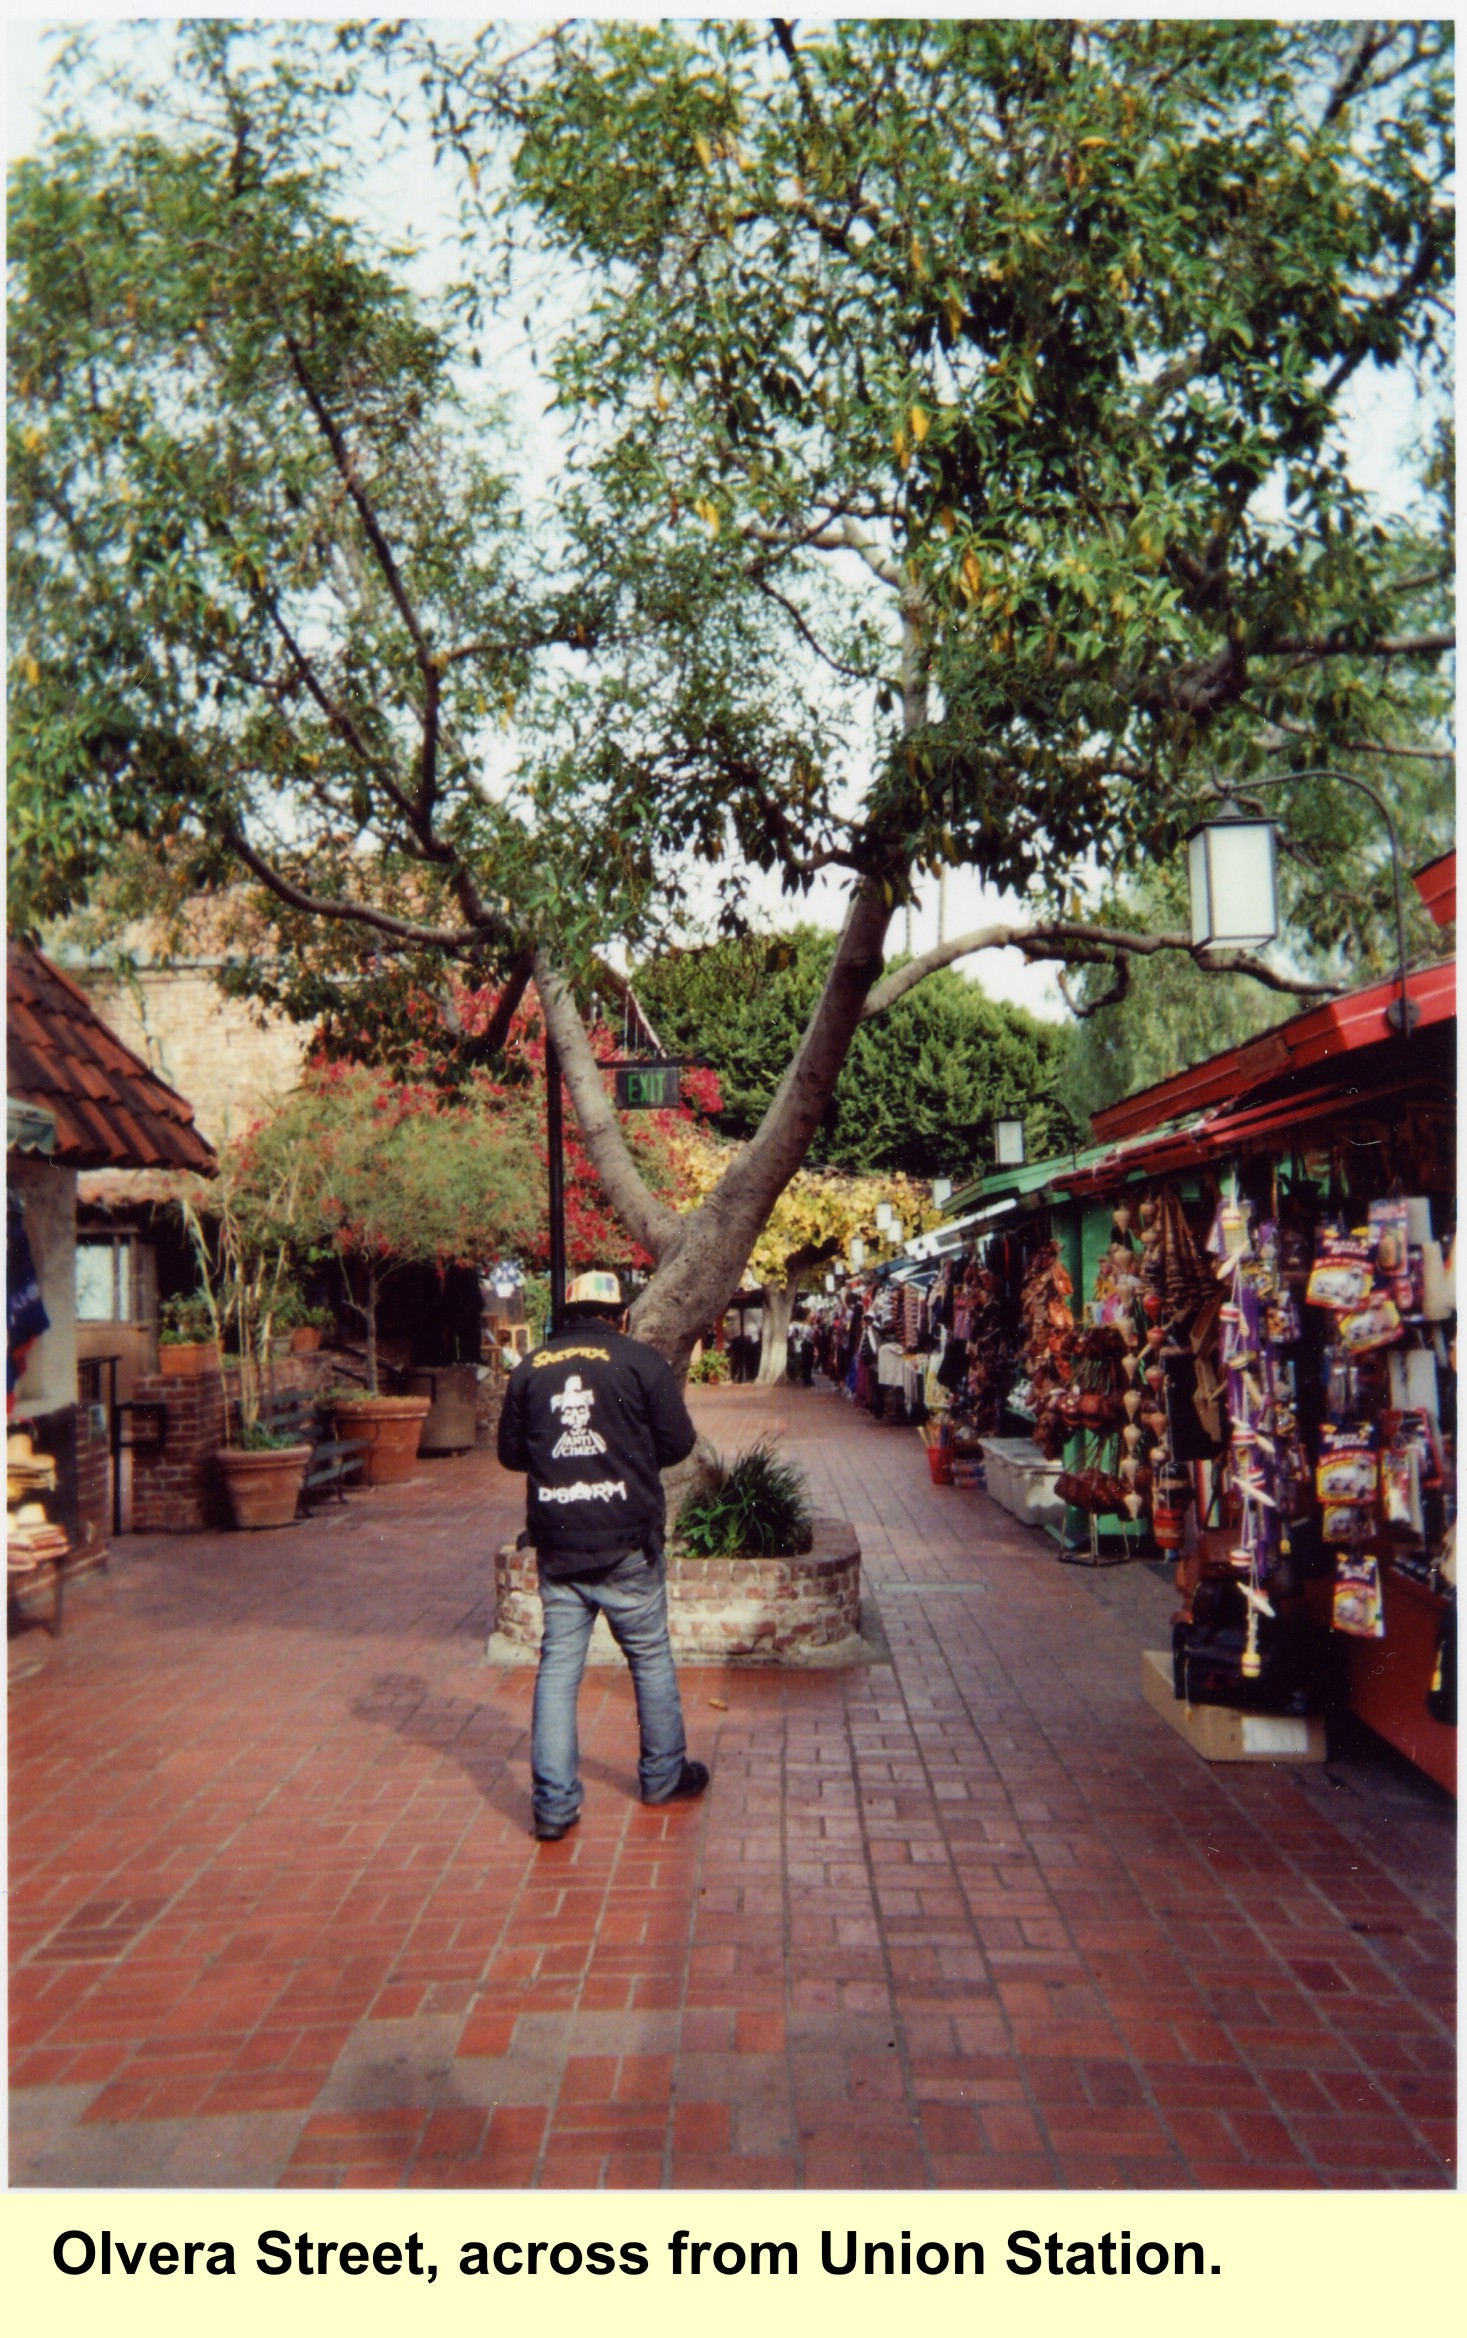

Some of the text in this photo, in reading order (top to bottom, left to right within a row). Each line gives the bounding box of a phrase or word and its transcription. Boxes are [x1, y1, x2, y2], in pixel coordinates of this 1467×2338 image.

[627, 1073, 666, 1102] EXIT
[561, 1435, 593, 1447] ANTI
[538, 1480, 627, 1504] DISARM
